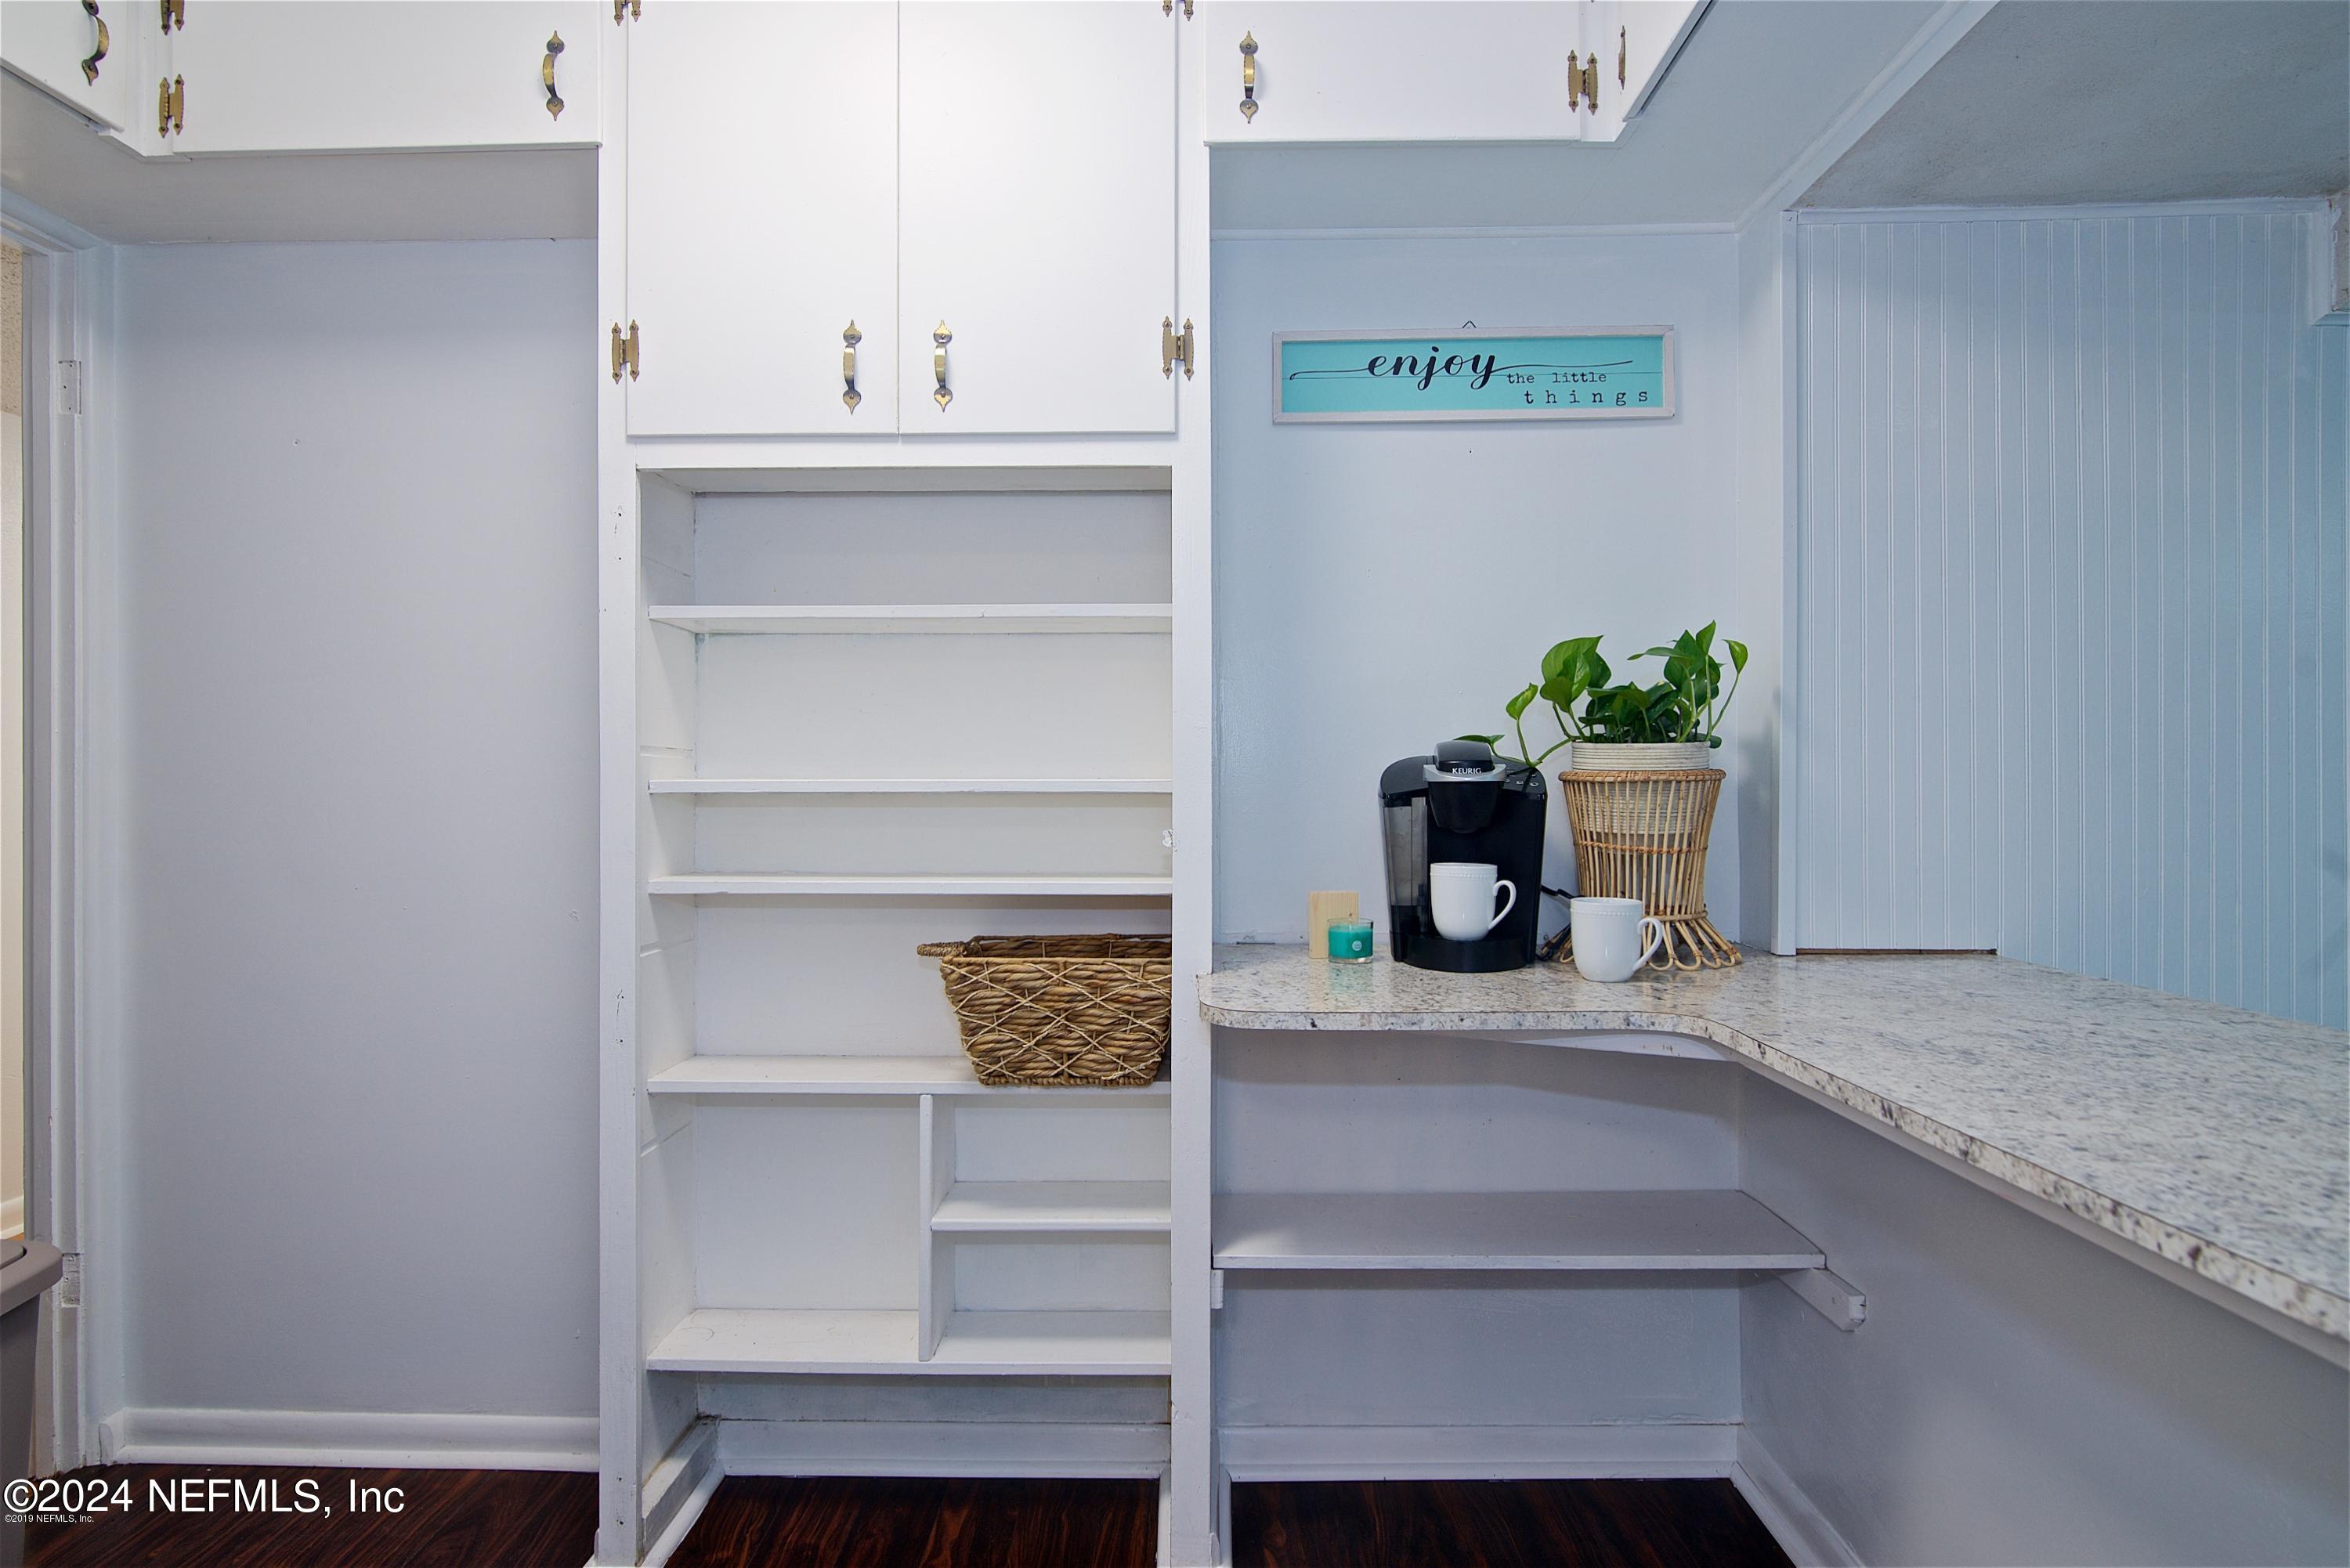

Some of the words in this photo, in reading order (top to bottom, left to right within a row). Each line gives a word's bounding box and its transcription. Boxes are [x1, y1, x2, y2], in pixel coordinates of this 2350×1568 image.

[1367, 345, 1496, 390] enjoy
[1506, 372, 1535, 384] the
[1552, 371, 1607, 383] little
[1524, 390, 1649, 406] things
